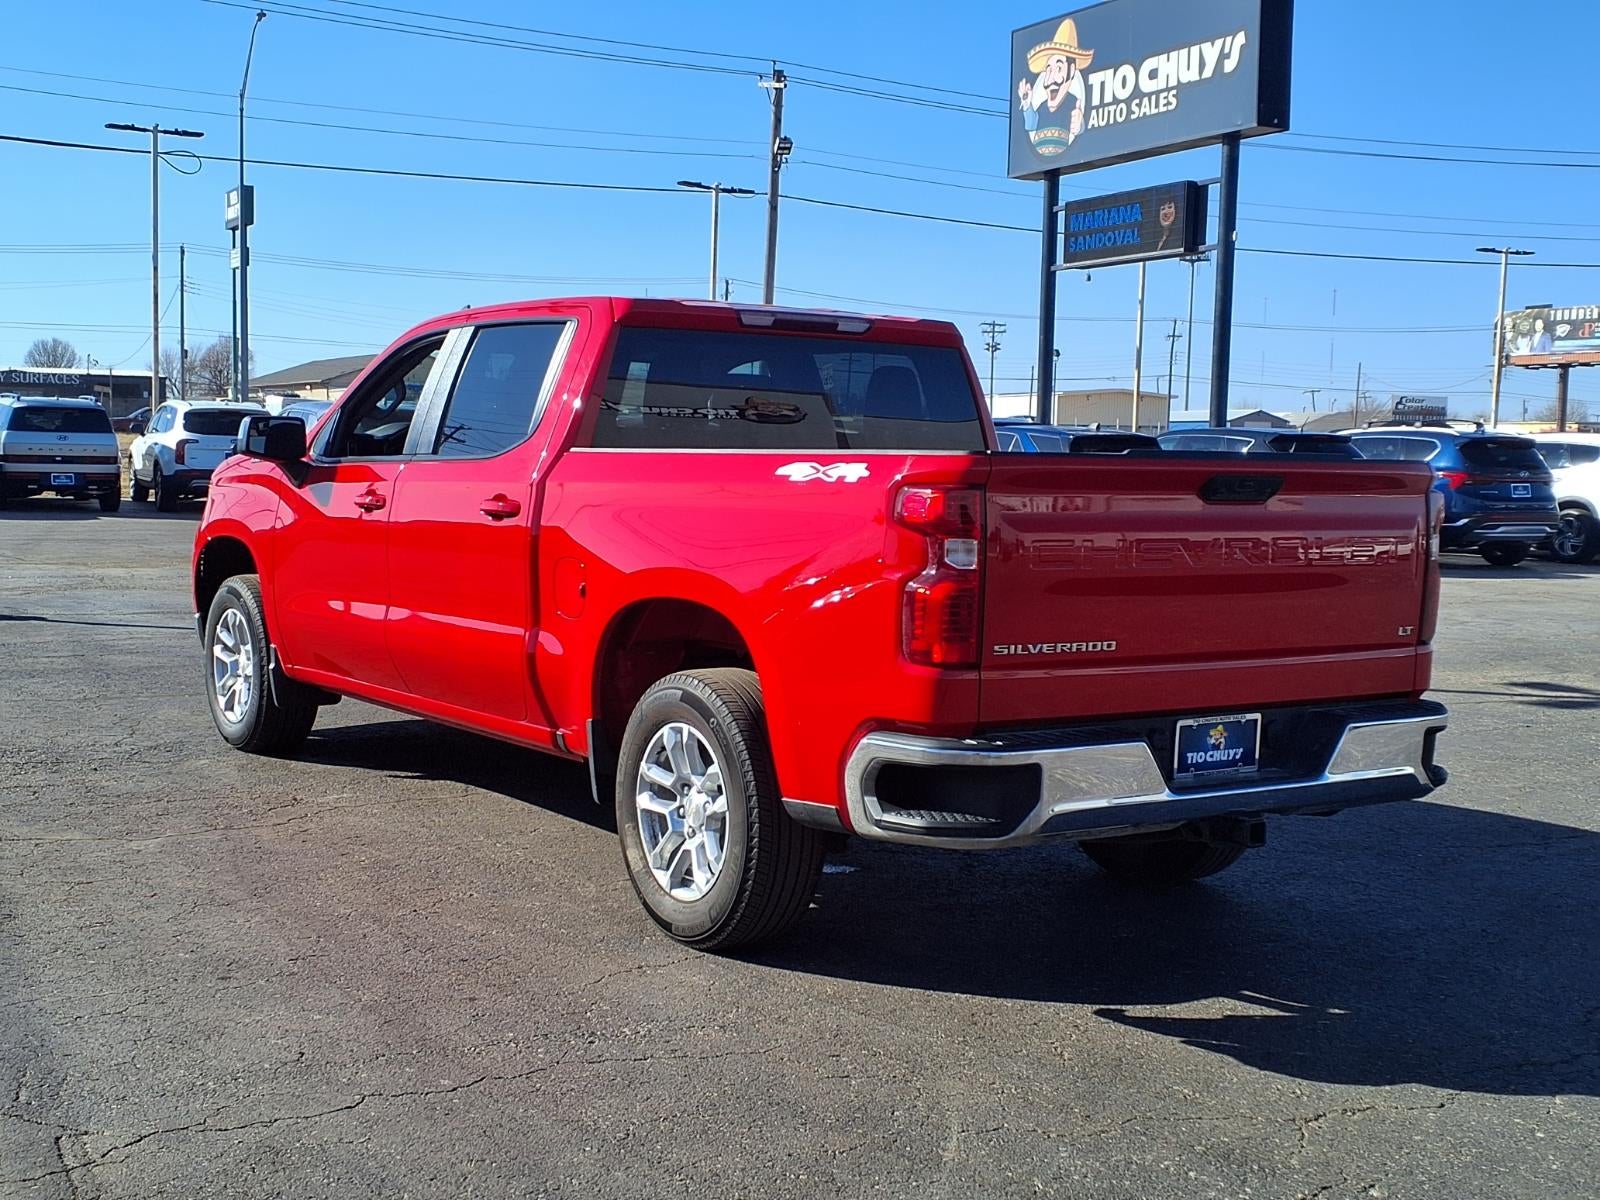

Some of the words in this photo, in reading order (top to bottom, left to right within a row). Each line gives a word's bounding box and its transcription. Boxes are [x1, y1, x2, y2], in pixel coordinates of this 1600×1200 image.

[1088, 64, 1136, 106] TIO
[1138, 30, 1246, 93] CHUY'S
[1087, 102, 1127, 129] AUTO
[1130, 89, 1178, 120] SALES
[1070, 203, 1143, 232] MARIANA
[1069, 227, 1141, 253] SANDOVAL
[11, 372, 80, 384] SURFACES
[1030, 536, 1413, 570] CHEVROLET
[1398, 625, 1414, 636] LT
[992, 640, 1118, 656] SILVERADO
[1186, 751, 1206, 764] TIO
[1205, 747, 1244, 762] CHUY'S
